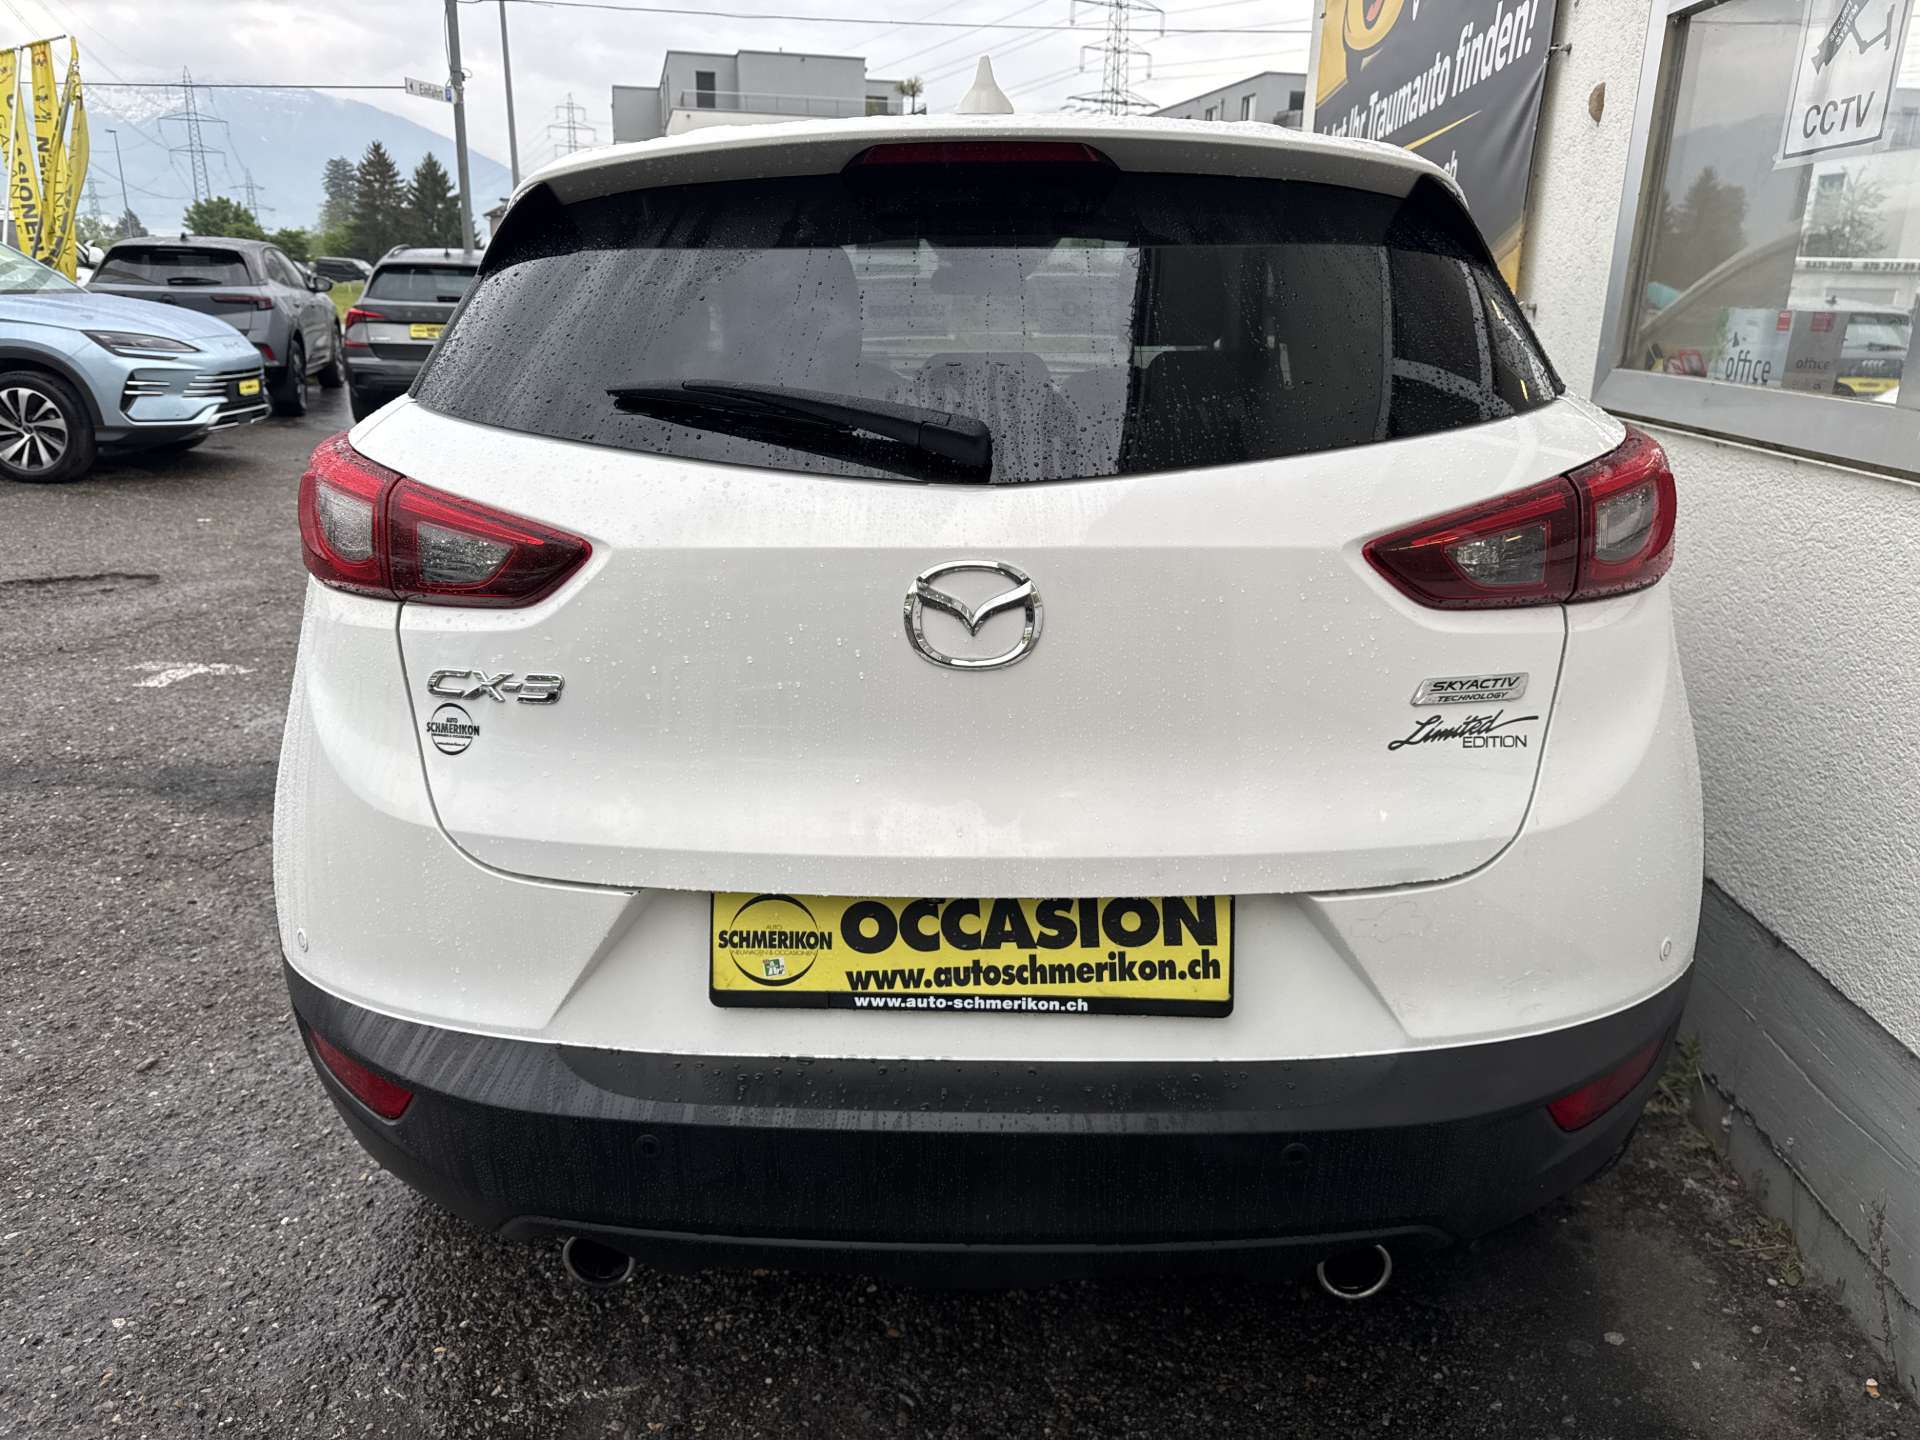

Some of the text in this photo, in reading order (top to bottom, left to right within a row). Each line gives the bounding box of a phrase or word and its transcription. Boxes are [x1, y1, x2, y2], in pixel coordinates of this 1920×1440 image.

[1830, 0, 1853, 41] SECURIT
[1367, 52, 1451, 140] Traumauto
[1451, 0, 1539, 98] finden!
[1802, 90, 1876, 140] CCTV
[1725, 349, 1772, 385] office
[1795, 357, 1832, 370] office
[427, 669, 566, 704] CX-3
[1430, 676, 1521, 692] SKYACTIV
[1437, 691, 1510, 703] TECHNOLOGY
[426, 721, 480, 736] SCHMERIKON
[1387, 709, 1539, 750] Limited
[1462, 734, 1528, 749] EDITION
[718, 930, 833, 950] SCHMERIKON
[840, 896, 1218, 954] OCCASION
[846, 949, 1221, 991] www.autoschmerikon.ch
[853, 996, 1089, 1012] www.auto-schmerikon.ch
